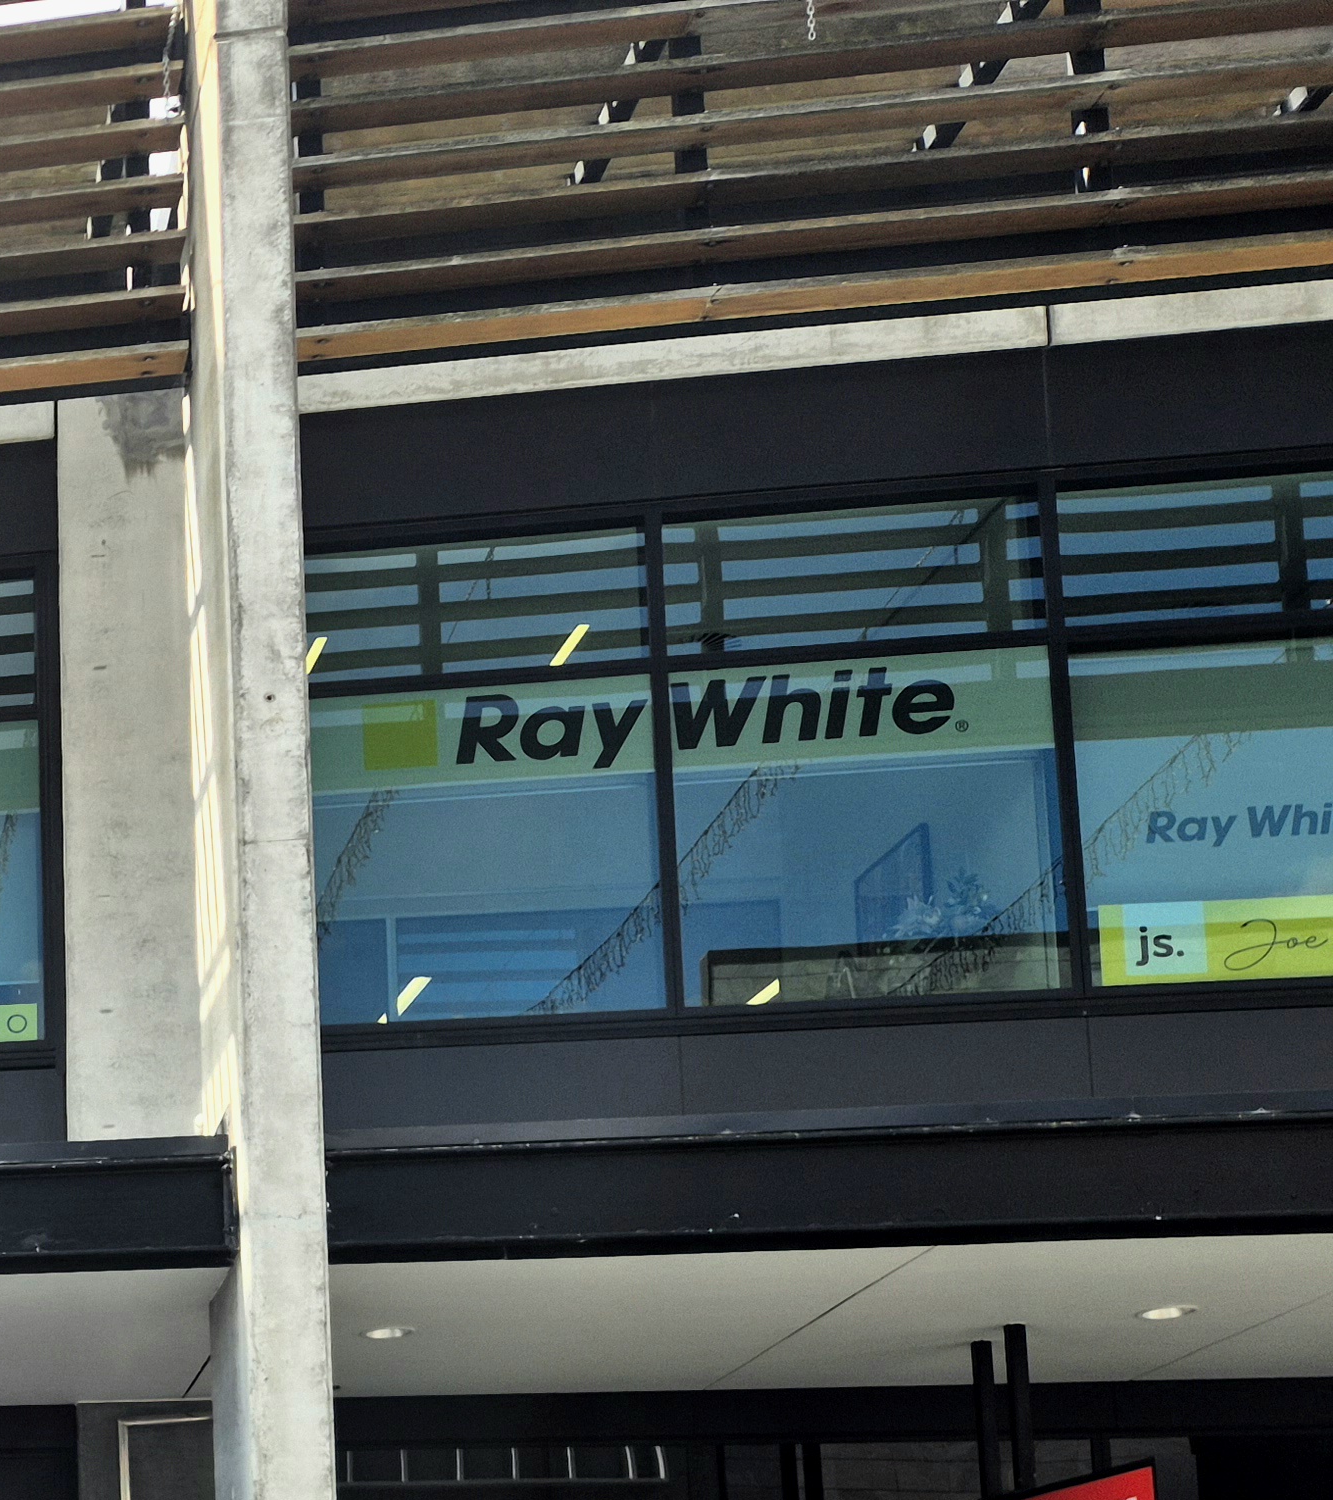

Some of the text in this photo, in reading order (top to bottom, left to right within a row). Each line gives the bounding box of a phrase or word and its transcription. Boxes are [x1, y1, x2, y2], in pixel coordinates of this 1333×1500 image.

[455, 668, 956, 770] Ray White
[1146, 811, 1237, 847] Ray
